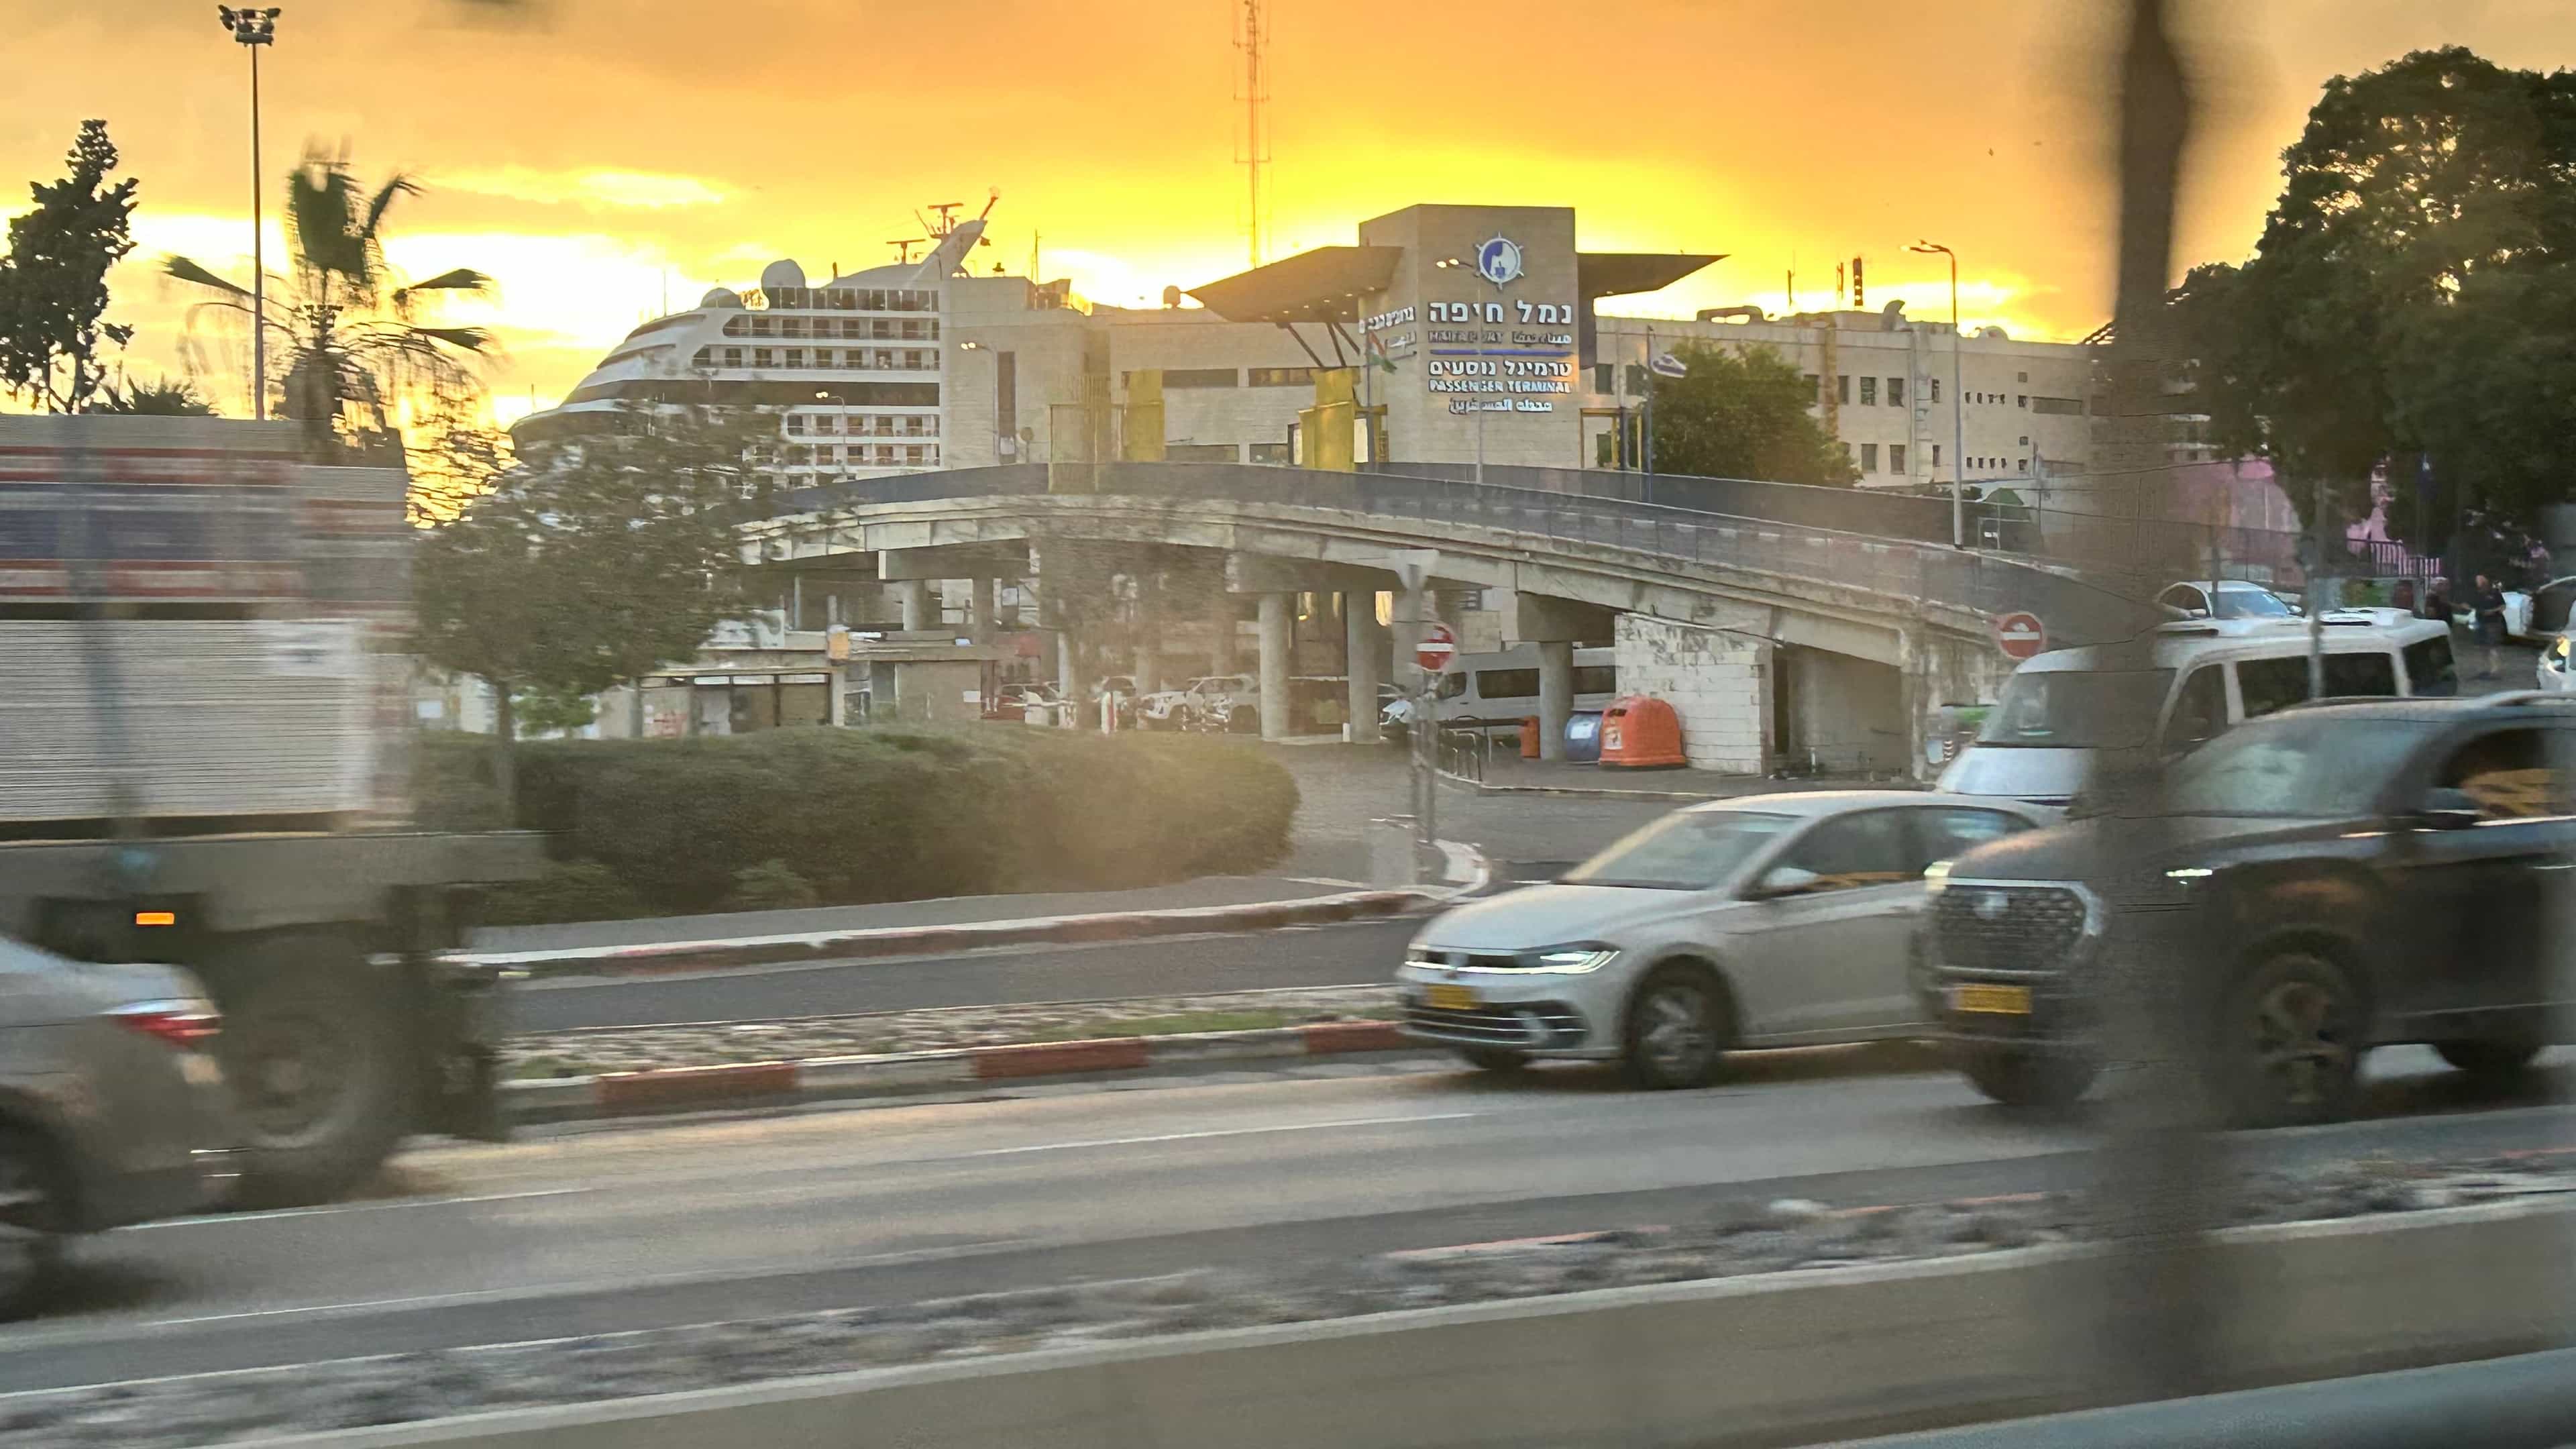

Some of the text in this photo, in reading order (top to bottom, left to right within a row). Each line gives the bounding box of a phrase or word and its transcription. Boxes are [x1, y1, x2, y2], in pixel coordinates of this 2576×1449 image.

[1428, 301, 1504, 323] חיפה
[1516, 300, 1572, 324] נמל
[1429, 360, 1573, 376] טרמינל נוסעים
[1429, 380, 1571, 393] PASSENGER TERMINAL
